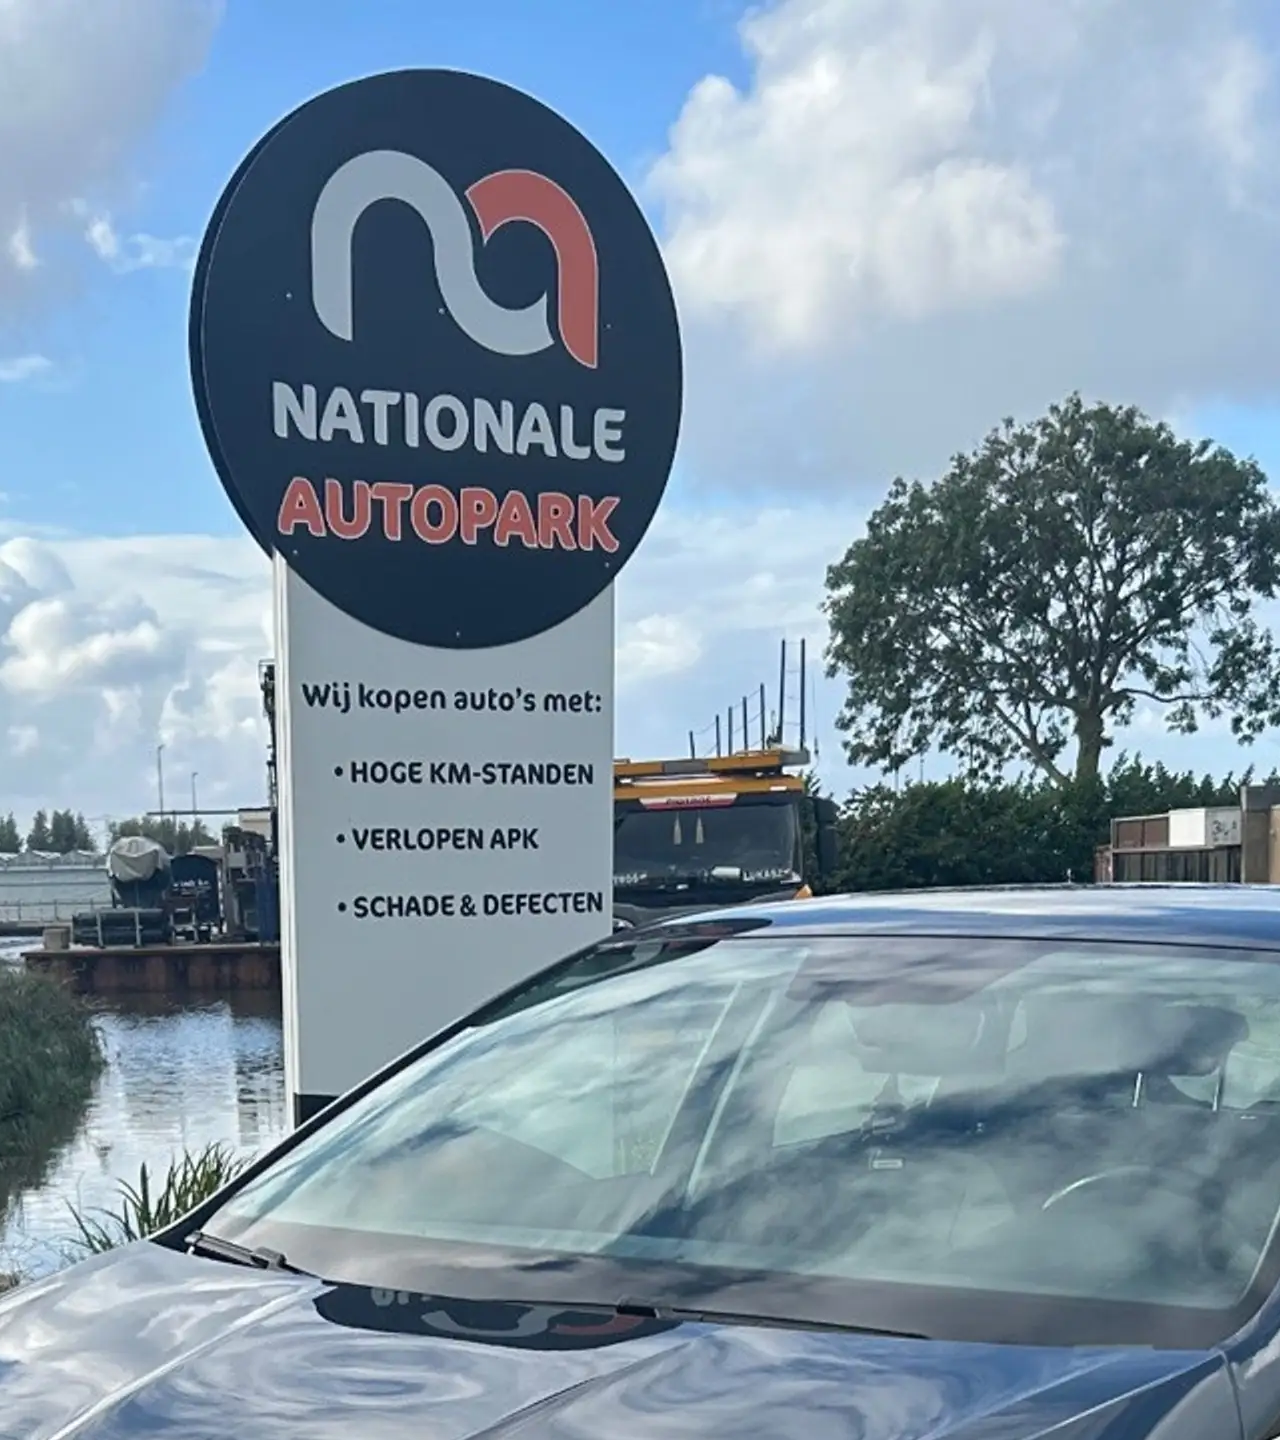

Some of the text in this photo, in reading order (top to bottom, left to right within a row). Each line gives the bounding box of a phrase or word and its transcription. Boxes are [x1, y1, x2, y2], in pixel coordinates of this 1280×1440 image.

[272, 380, 626, 463] NATIONALE
[277, 476, 620, 552] AUTOPARK
[302, 683, 602, 713] Wij kopen auto's met:
[350, 761, 594, 785] HOGE KM-STANDEN
[352, 827, 539, 850] VERLOPEN APK
[353, 892, 604, 918] SCHADE & DEFECTEN
